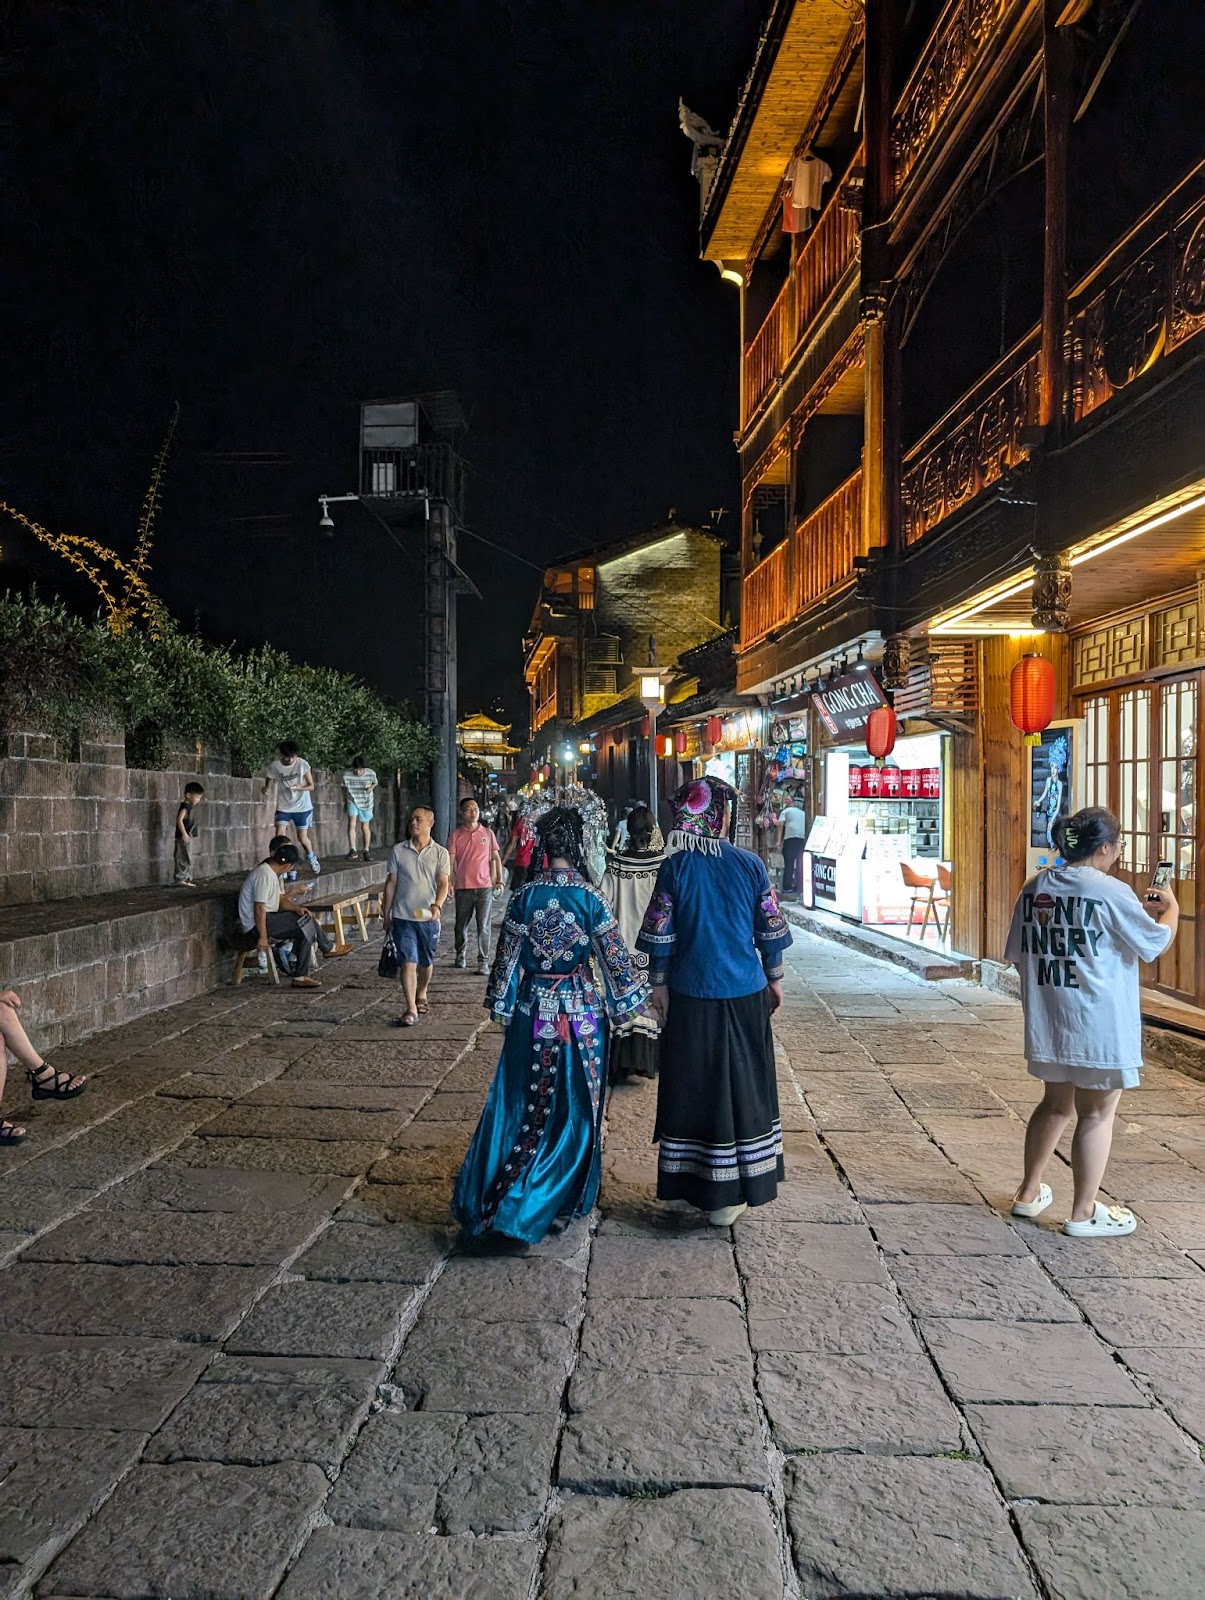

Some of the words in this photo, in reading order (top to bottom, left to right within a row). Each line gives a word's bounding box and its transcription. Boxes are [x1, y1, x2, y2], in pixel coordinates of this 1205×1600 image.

[822, 687, 857, 714] GONG
[850, 680, 880, 707] CHA
[1021, 925, 1104, 958] ANGRY
[1037, 958, 1080, 989] ME
